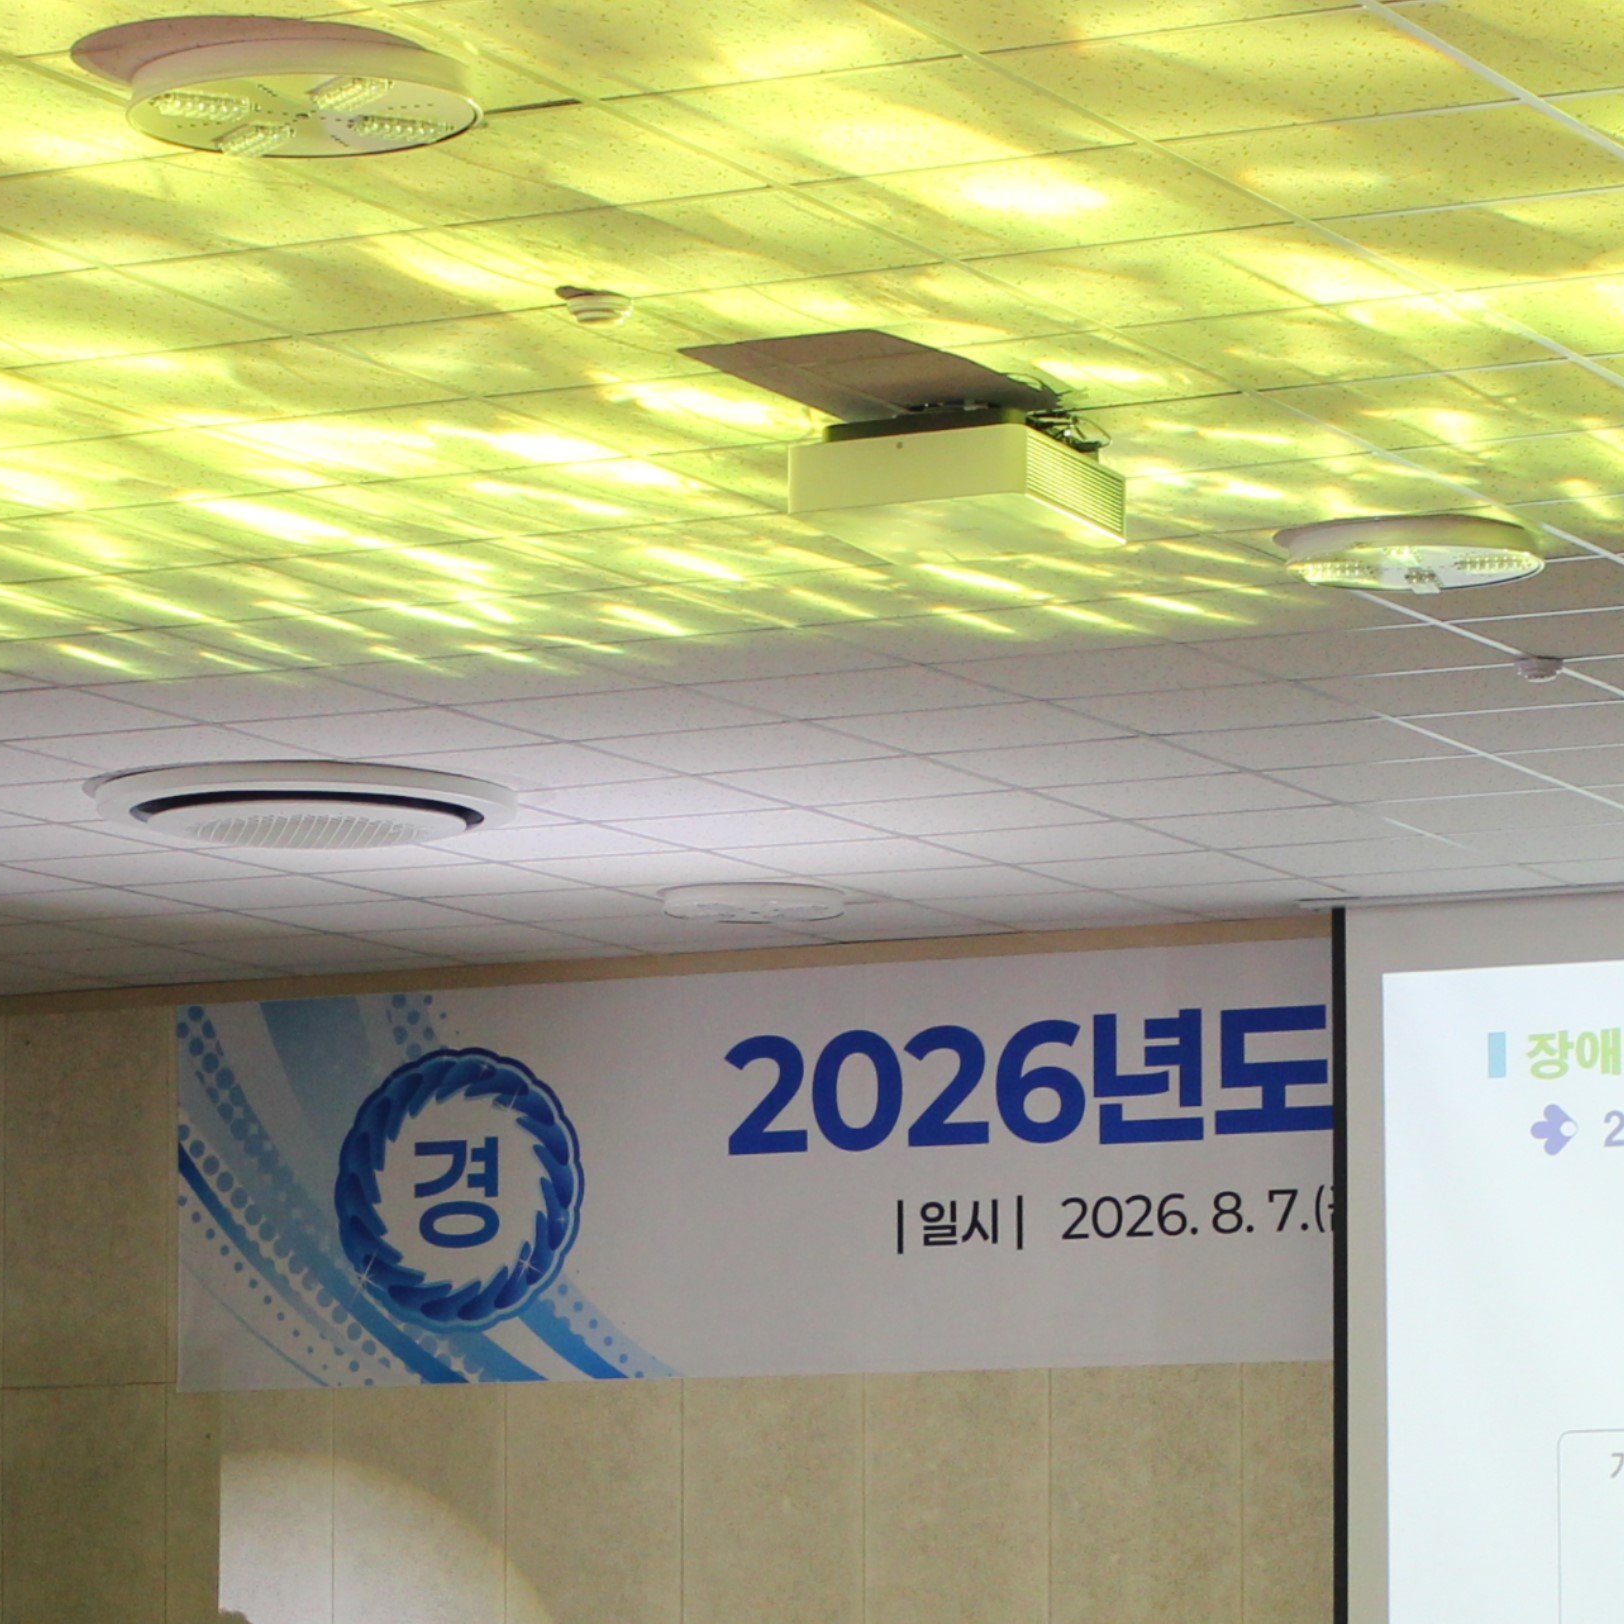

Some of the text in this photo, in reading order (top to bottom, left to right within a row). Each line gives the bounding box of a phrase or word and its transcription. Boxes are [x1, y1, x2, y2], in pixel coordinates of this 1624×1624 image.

[723, 1004, 1333, 1158] 2026년도
[413, 1135, 500, 1252] 경
[1061, 1193, 1199, 1240] 2026.
[1211, 1191, 1255, 1236] 8.
